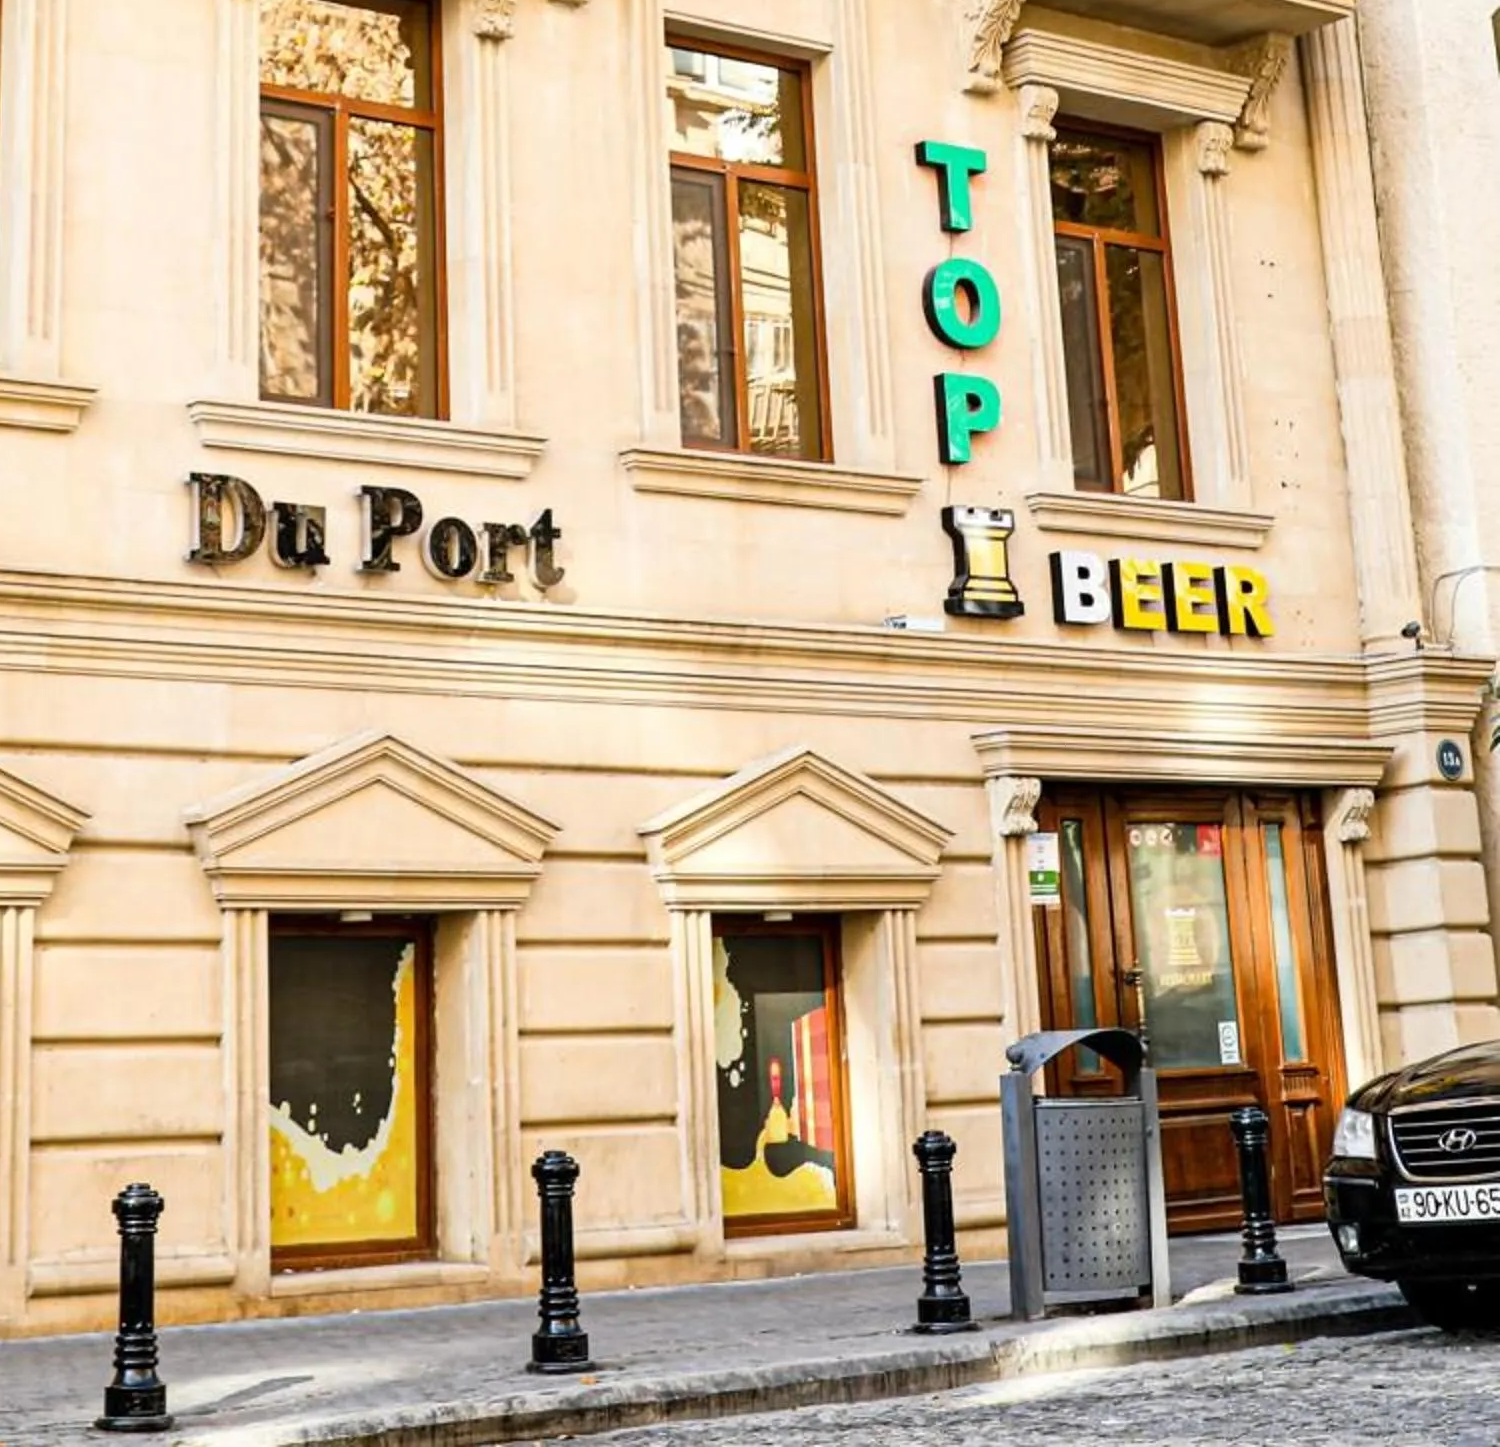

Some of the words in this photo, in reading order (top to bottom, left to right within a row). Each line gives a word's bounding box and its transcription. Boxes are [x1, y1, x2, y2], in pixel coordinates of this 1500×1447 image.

[915, 140, 1000, 465] TOP
[184, 471, 330, 570] Du
[354, 484, 564, 591] Port
[1049, 549, 1275, 639] BEER
